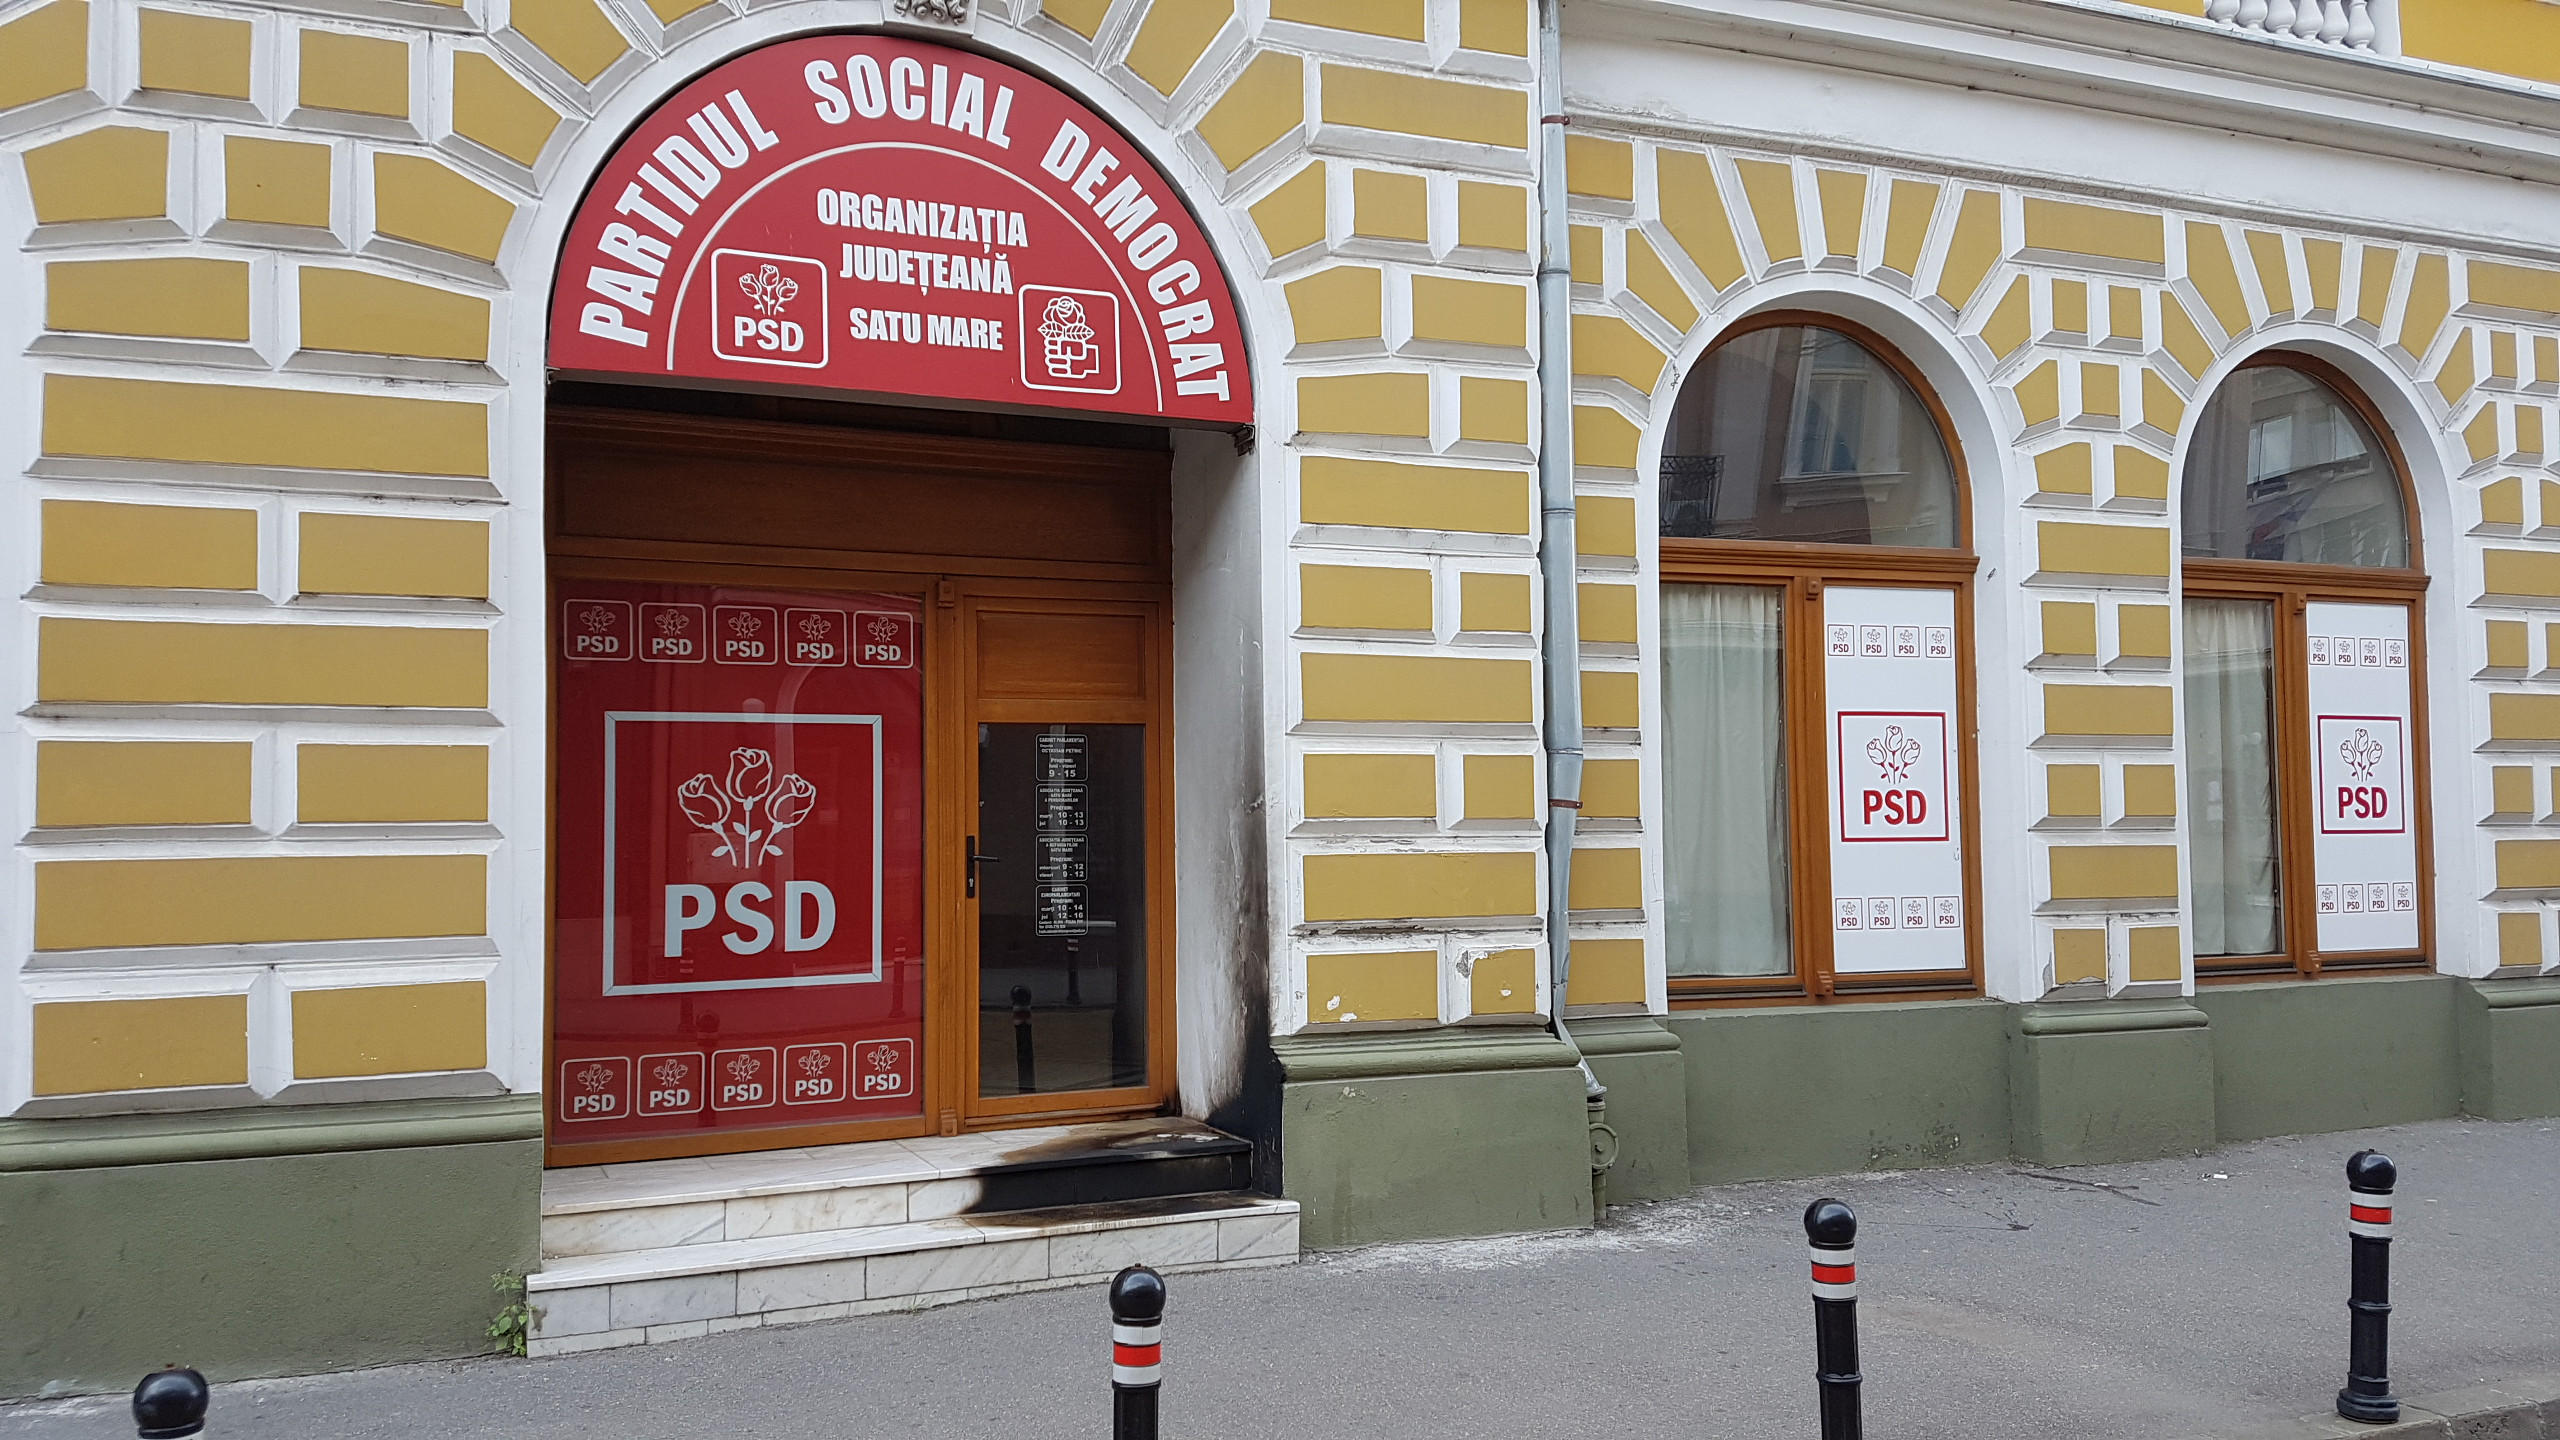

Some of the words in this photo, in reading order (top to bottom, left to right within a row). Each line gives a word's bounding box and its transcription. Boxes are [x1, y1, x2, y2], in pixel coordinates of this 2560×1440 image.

[579, 89, 779, 346] PARTIDUL
[803, 53, 1014, 148] SOCIAL
[1040, 118, 1230, 401] DEMOCRAT
[818, 189, 1028, 254] ORGANIZAȚIA
[840, 243, 1013, 296] JUDEȚEANĂ
[735, 316, 803, 351] PSD
[850, 308, 921, 343] SATU
[928, 315, 1003, 350] MARE
[578, 636, 618, 652] PSD
[653, 638, 692, 655] PSD
[726, 641, 764, 657] PSD
[797, 643, 834, 659] PSD
[865, 645, 901, 660] PSD
[1832, 643, 1850, 653] PSD
[1865, 644, 1883, 654] PSD
[1898, 644, 1915, 655] PSD
[1930, 645, 1947, 655] PSD
[2312, 653, 2326, 662] PSD
[2338, 654, 2352, 663] PSD
[2363, 654, 2377, 664] PSD
[2389, 655, 2402, 665] PSD
[1864, 790, 1926, 825] PSD
[2338, 787, 2387, 818] PSD
[665, 881, 835, 957] PSD
[1841, 917, 1858, 927] PSD
[1873, 916, 1891, 926] PSD
[1906, 915, 1924, 926] PSD
[1939, 915, 1955, 925] PSD
[2321, 901, 2335, 911] PSD
[2346, 901, 2360, 910] PSD
[2372, 900, 2386, 909] PSD
[2397, 899, 2410, 908] PSD
[574, 1094, 615, 1113] PSD
[650, 1089, 690, 1107] PSD
[724, 1084, 763, 1102] PSD
[795, 1079, 832, 1096] PSD
[865, 1074, 901, 1090] PSD
